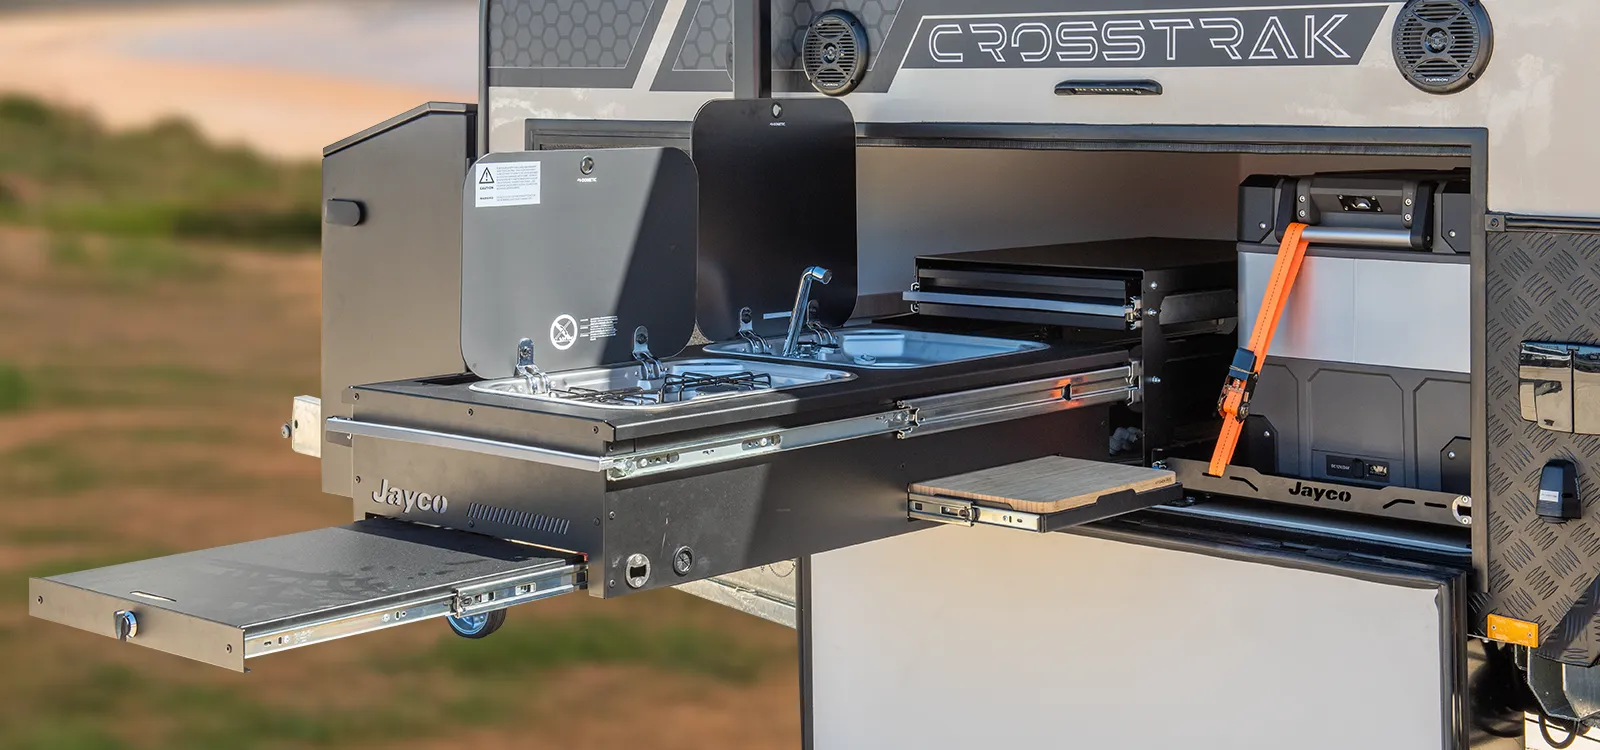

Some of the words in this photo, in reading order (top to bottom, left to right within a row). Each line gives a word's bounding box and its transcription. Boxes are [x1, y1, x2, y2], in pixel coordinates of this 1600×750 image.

[928, 14, 1351, 63] CROSSTRAK
[372, 479, 448, 513] Jayco
[1288, 481, 1352, 502] Jayco
